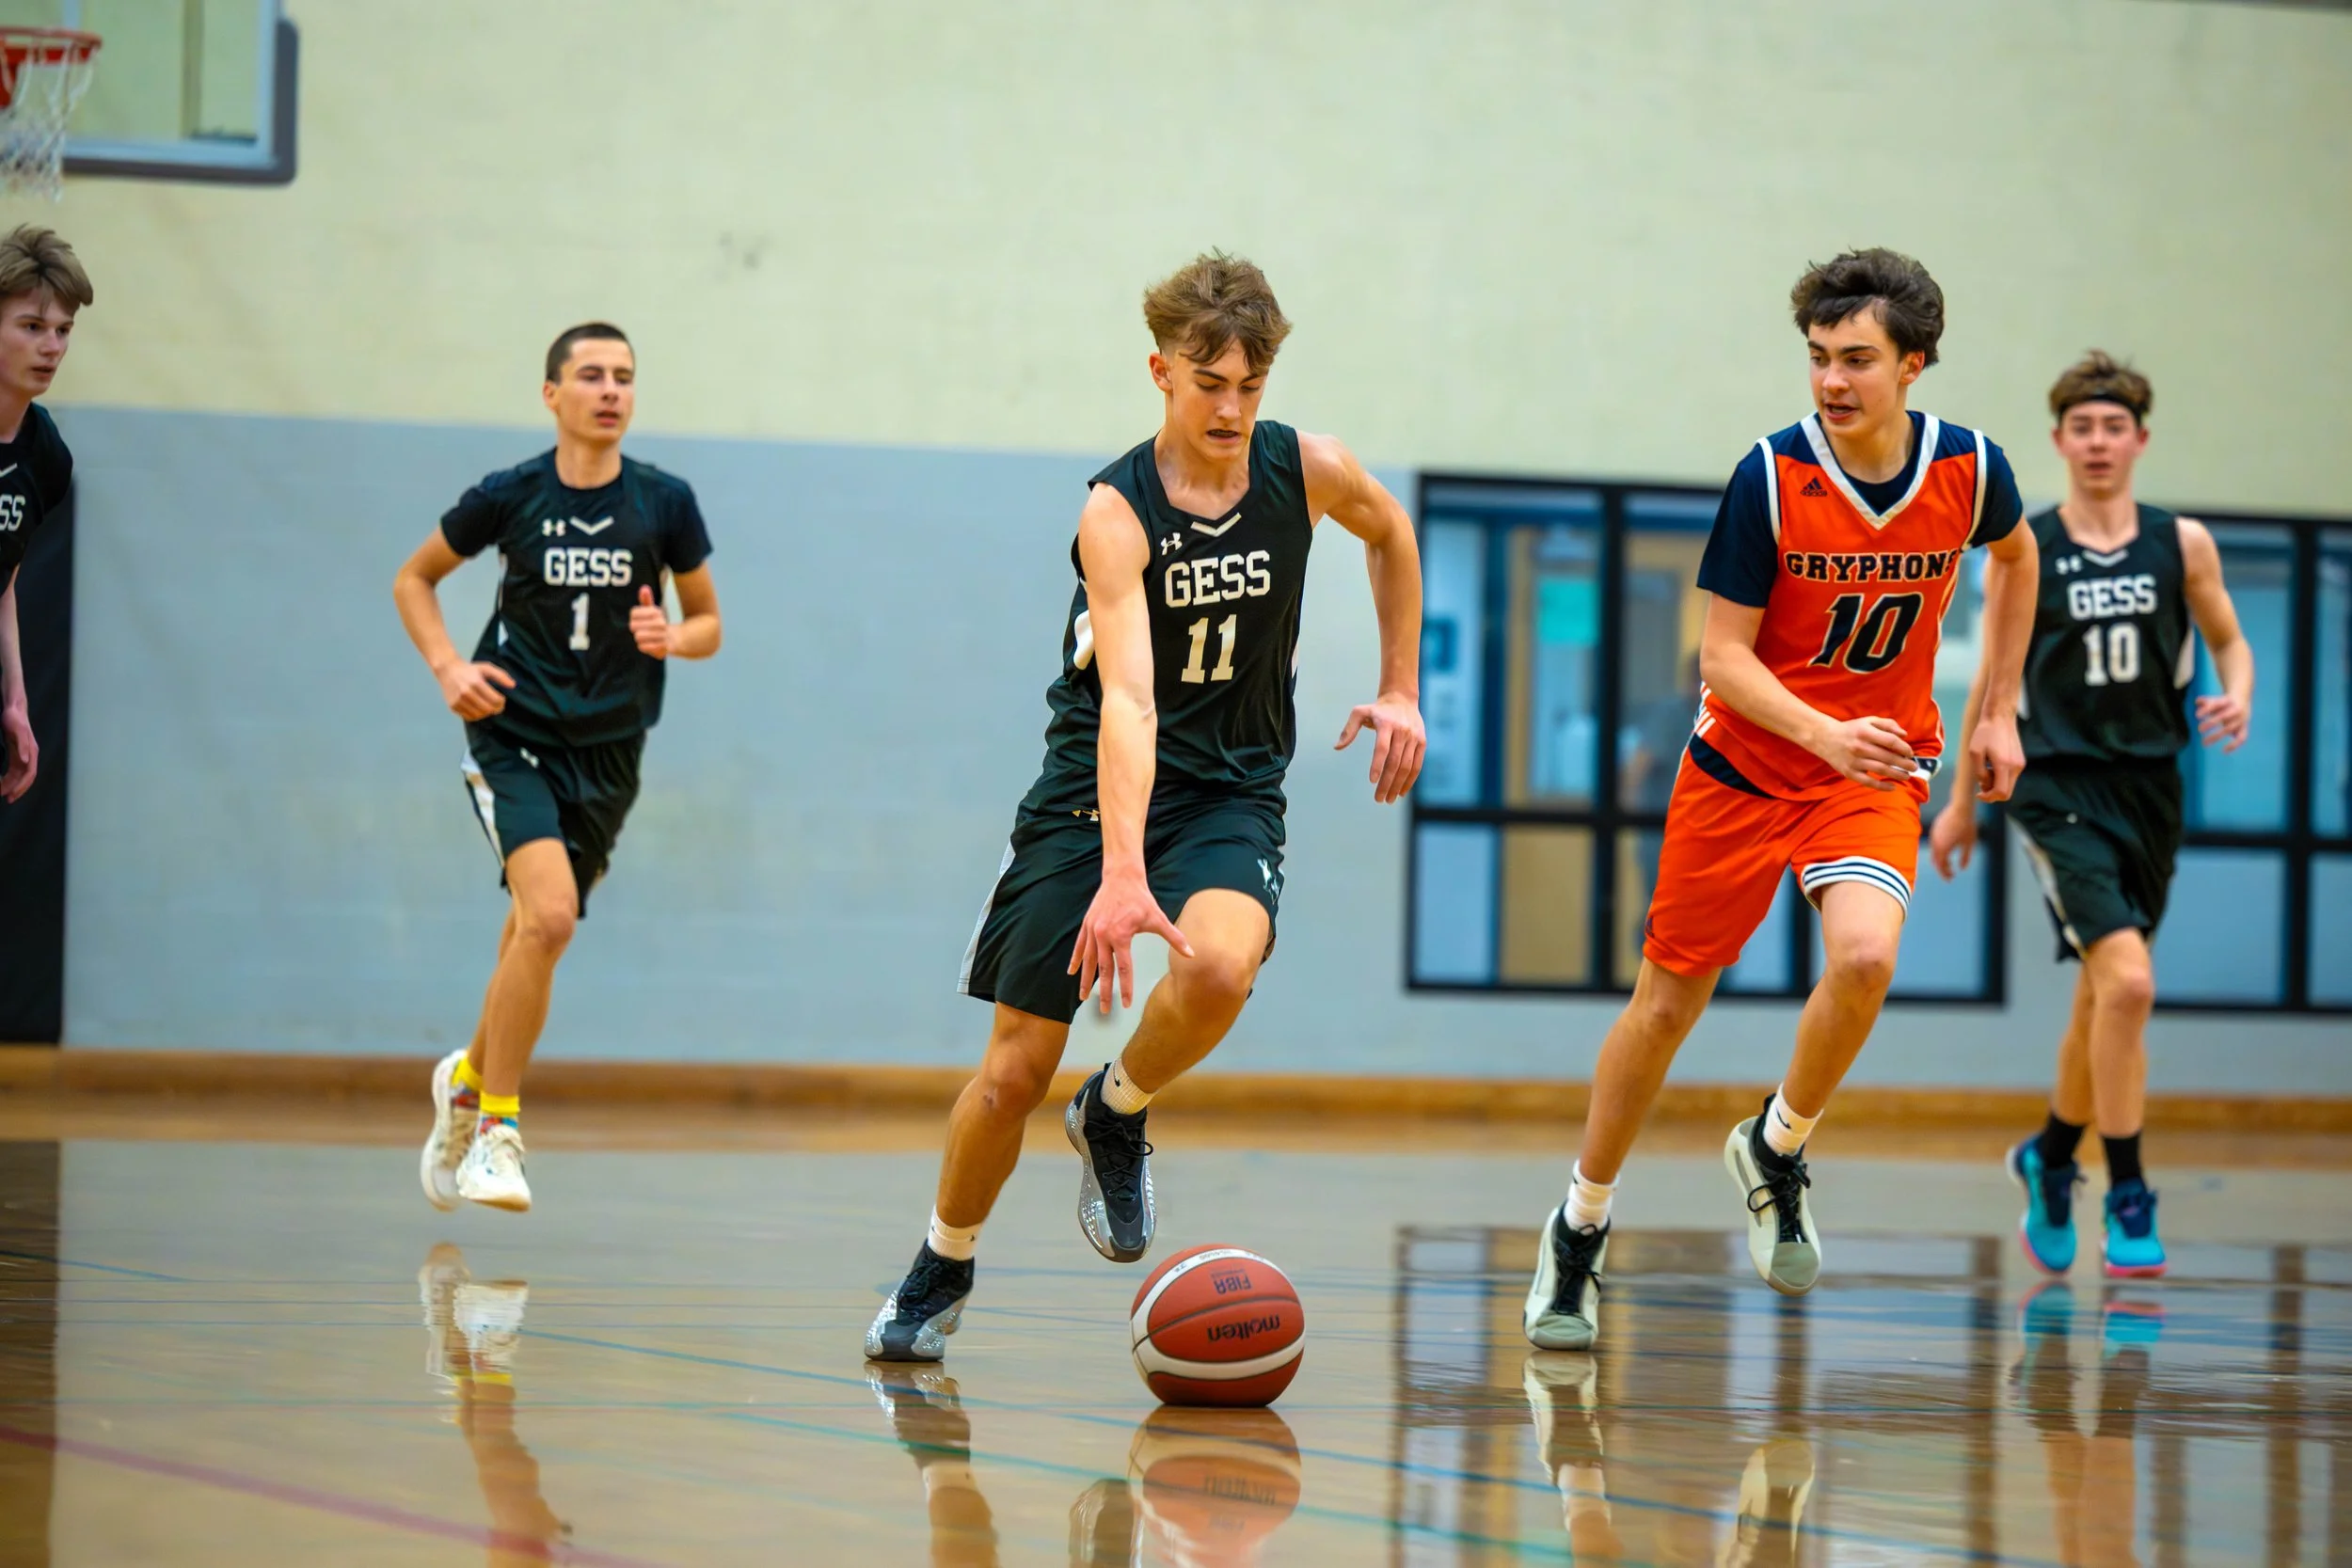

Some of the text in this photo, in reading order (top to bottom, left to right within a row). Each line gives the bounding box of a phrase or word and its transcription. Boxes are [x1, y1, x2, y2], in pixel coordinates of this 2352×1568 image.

[544, 546, 633, 587] GESS
[1165, 549, 1270, 608] GESS
[569, 592, 590, 651] 1
[2067, 573, 2157, 621] GESS
[1181, 614, 1237, 684] 11
[1806, 591, 1925, 674] 10
[2082, 622, 2140, 687] 10
[1213, 1273, 1252, 1295] FIBA
[1207, 1314, 1281, 1342] molten
